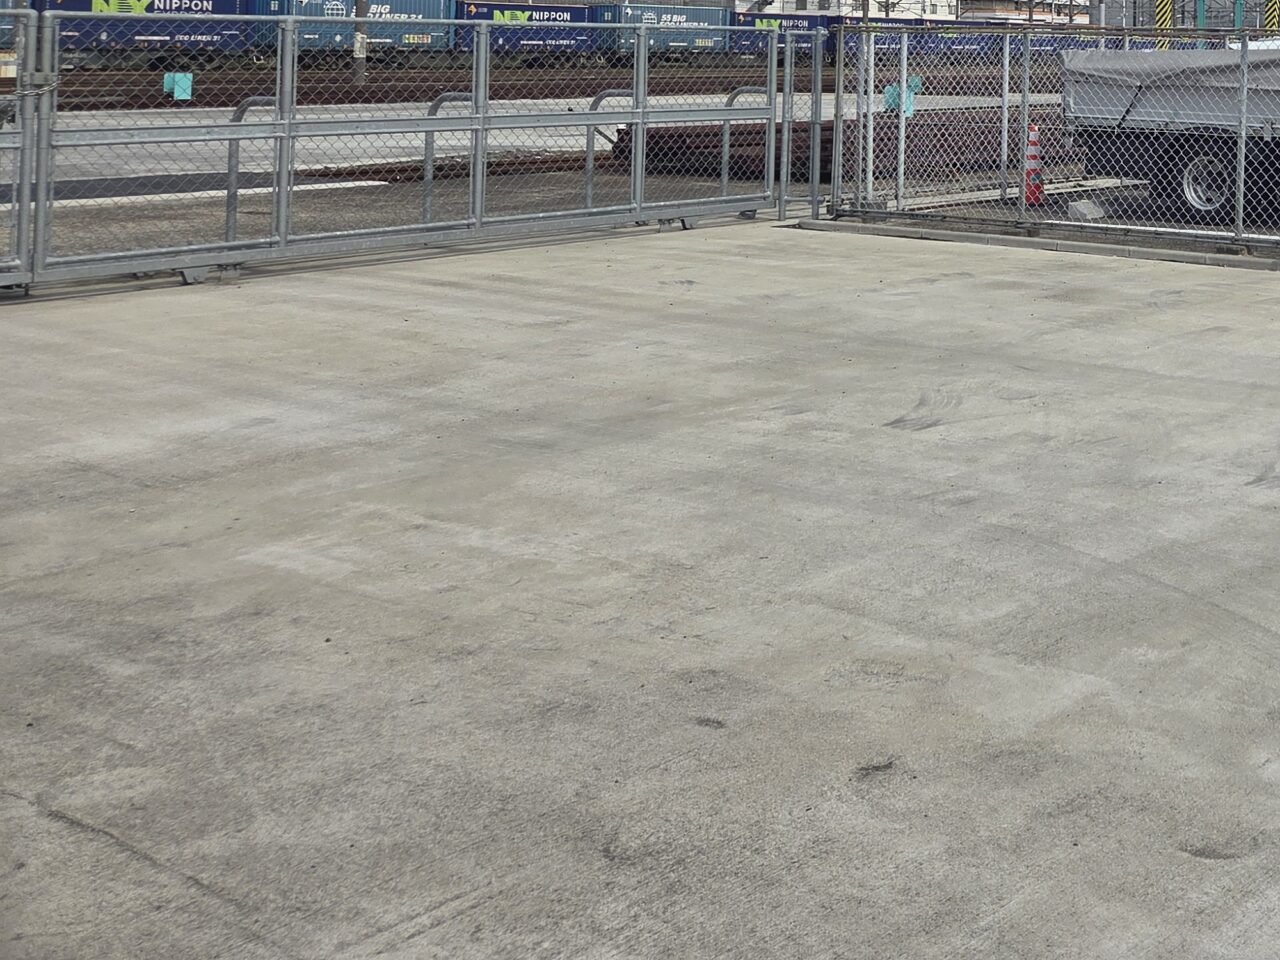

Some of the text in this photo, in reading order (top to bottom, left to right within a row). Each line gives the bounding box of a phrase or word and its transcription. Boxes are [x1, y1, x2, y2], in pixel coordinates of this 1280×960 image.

[154, 0, 212, 11] NIPPON
[370, 4, 390, 13] BIG
[532, 12, 571, 21] NIPPON
